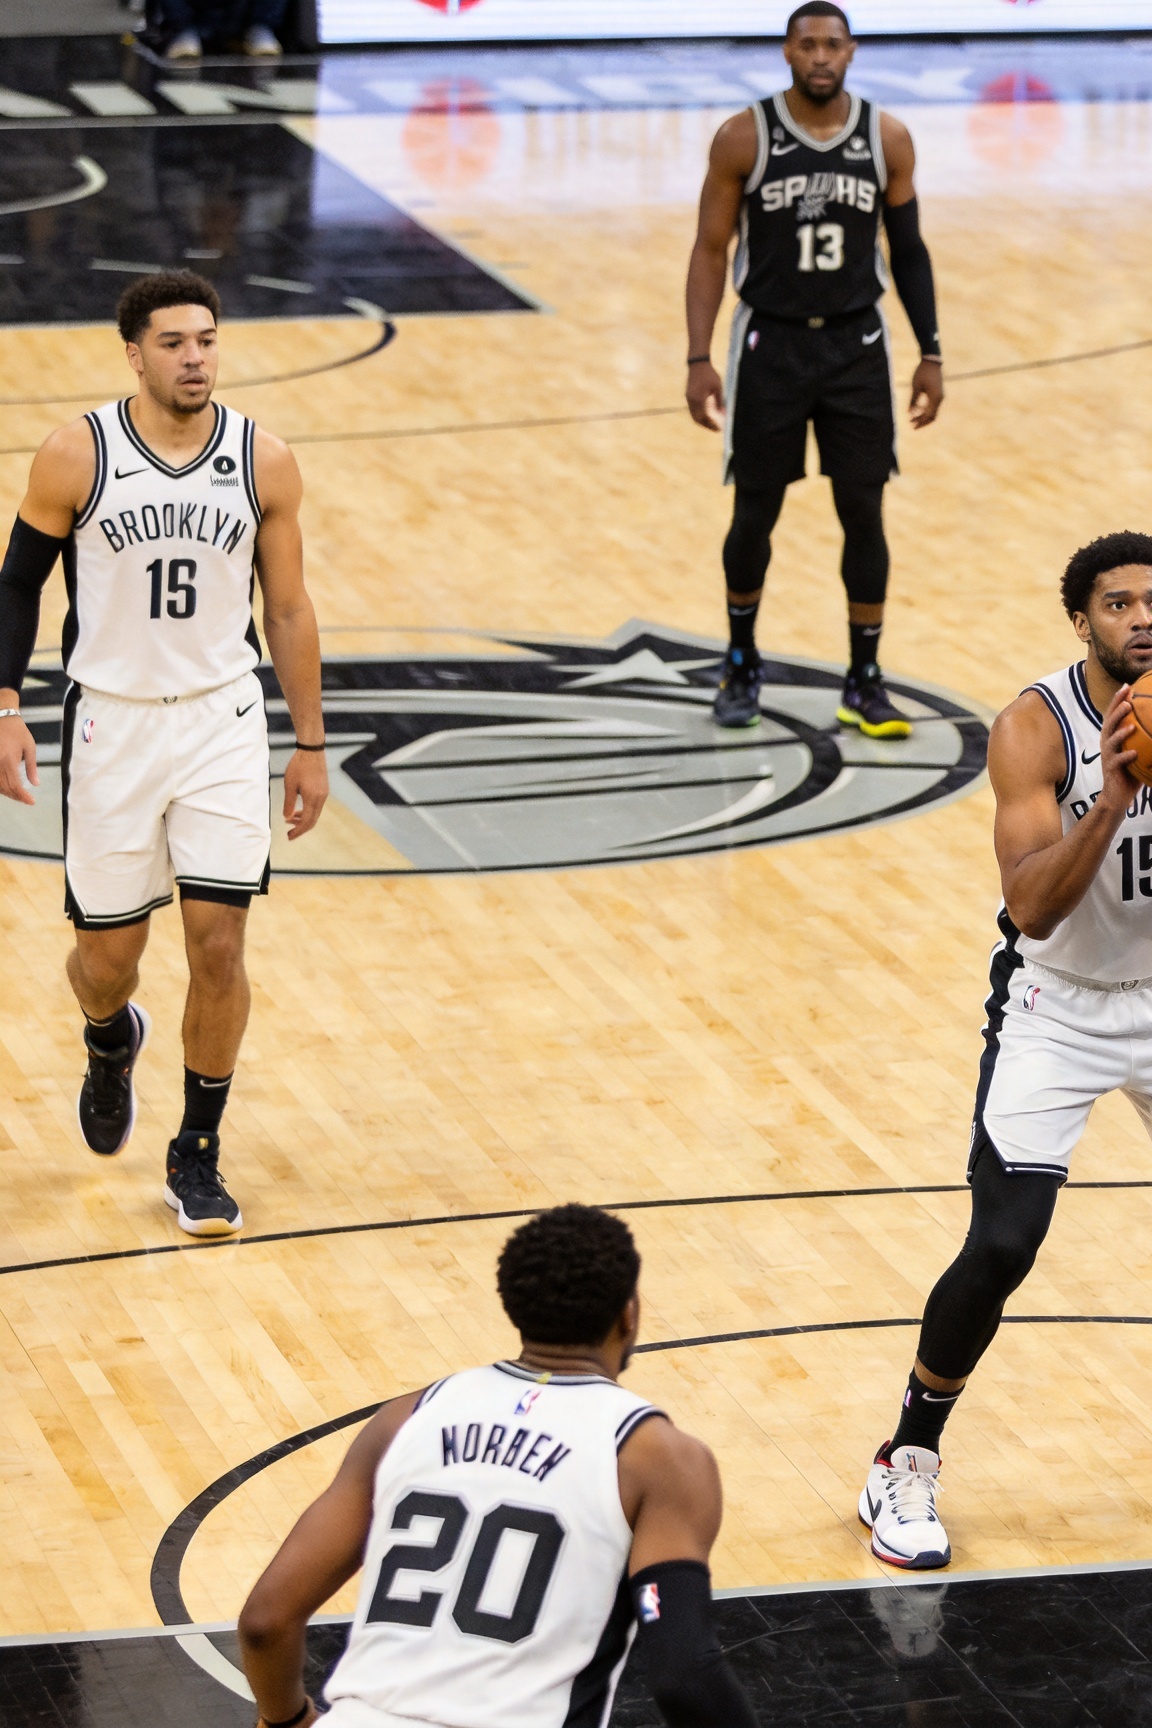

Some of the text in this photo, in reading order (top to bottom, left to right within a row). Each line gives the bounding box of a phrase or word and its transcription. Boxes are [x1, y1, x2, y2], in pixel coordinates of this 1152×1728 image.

[796, 222, 844, 272] 13
[98, 502, 248, 555] BROOKLYN
[364, 1489, 566, 1645] 20
